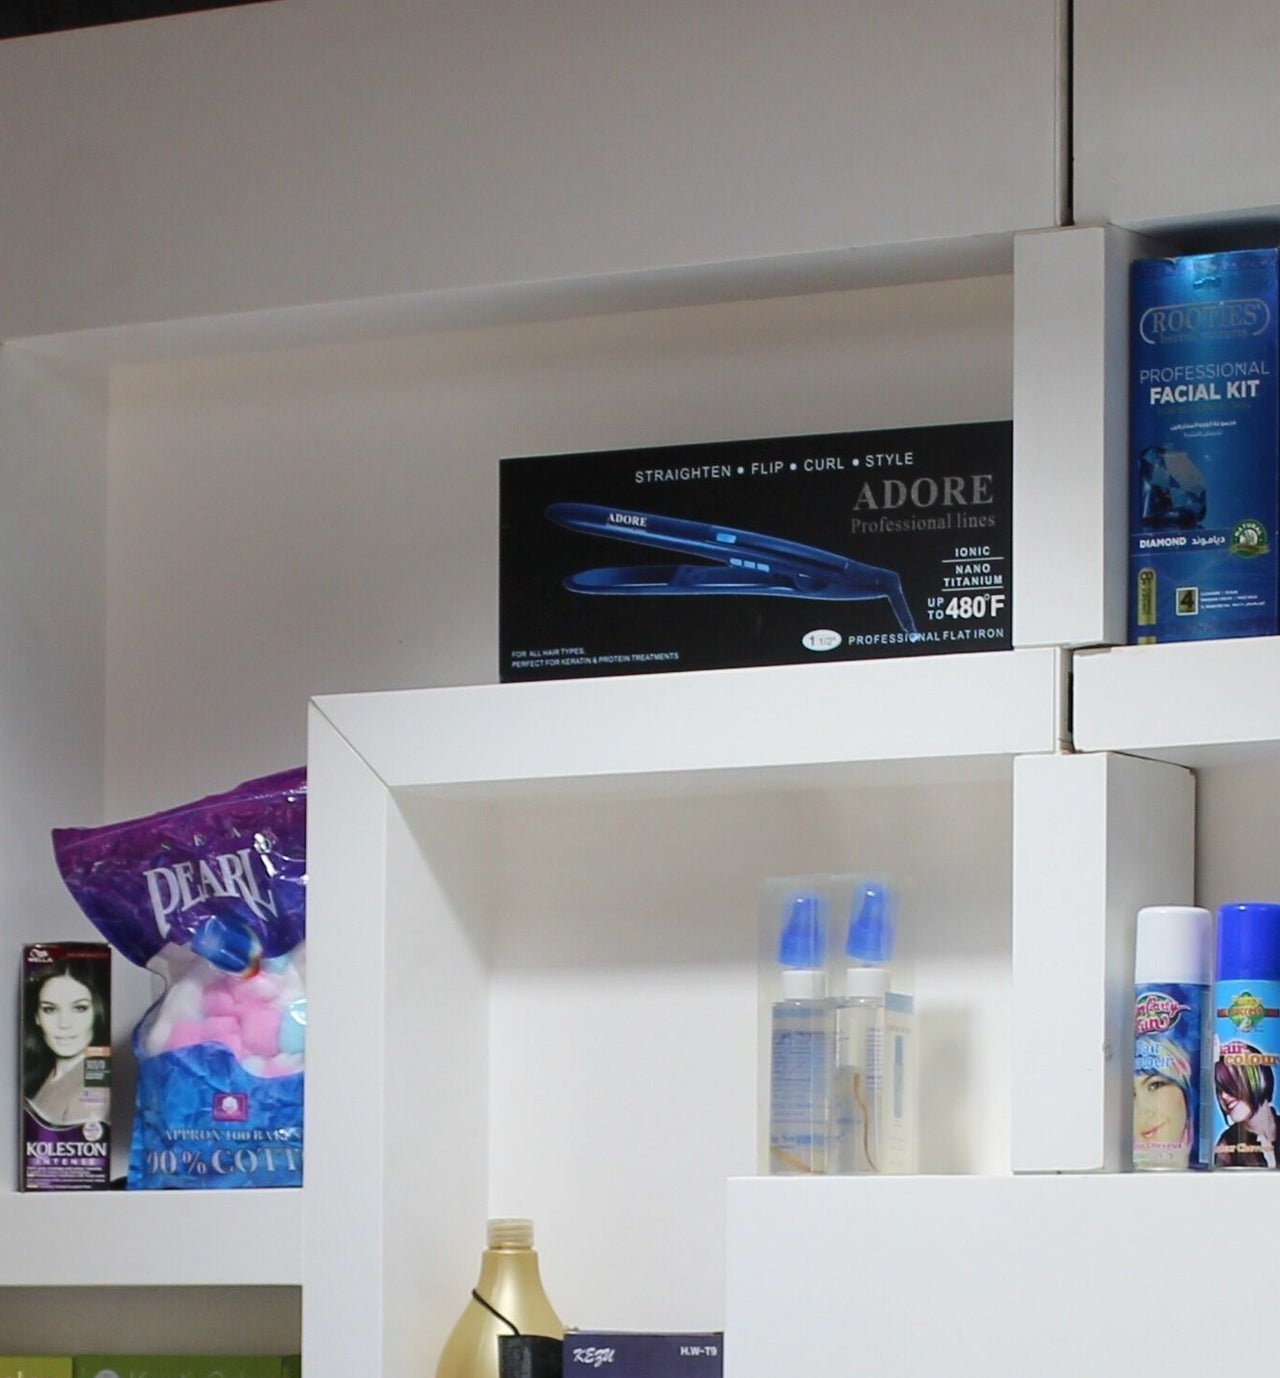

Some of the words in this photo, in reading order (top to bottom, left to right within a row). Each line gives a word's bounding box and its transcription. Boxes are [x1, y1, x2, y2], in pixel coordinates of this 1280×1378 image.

[1140, 361, 1271, 384] PROFESSIONAL
[1150, 383, 1222, 405] FACIAL
[1226, 380, 1260, 399] KIT
[635, 465, 732, 484] STRAIGHTEN
[751, 461, 785, 476] FLIP
[803, 457, 845, 472] CURL
[865, 452, 914, 468] STYLE
[853, 474, 994, 512] ADORE
[608, 512, 648, 528] ADORE
[851, 513, 953, 535] Professional
[957, 512, 996, 529] lines
[1139, 537, 1187, 549] DIAMOND
[955, 546, 991, 558] IONIC
[955, 564, 991, 575] NANO
[943, 575, 1003, 588] TITANIUM
[927, 597, 945, 608] UP
[1180, 589, 1195, 610] 4
[927, 610, 945, 620] TO
[942, 630, 971, 641] FLAT
[973, 628, 1005, 639] IRON
[143, 846, 278, 939] PEARL
[1224, 1053, 1280, 1067] colour
[26, 1142, 107, 1158] KOLESTON
